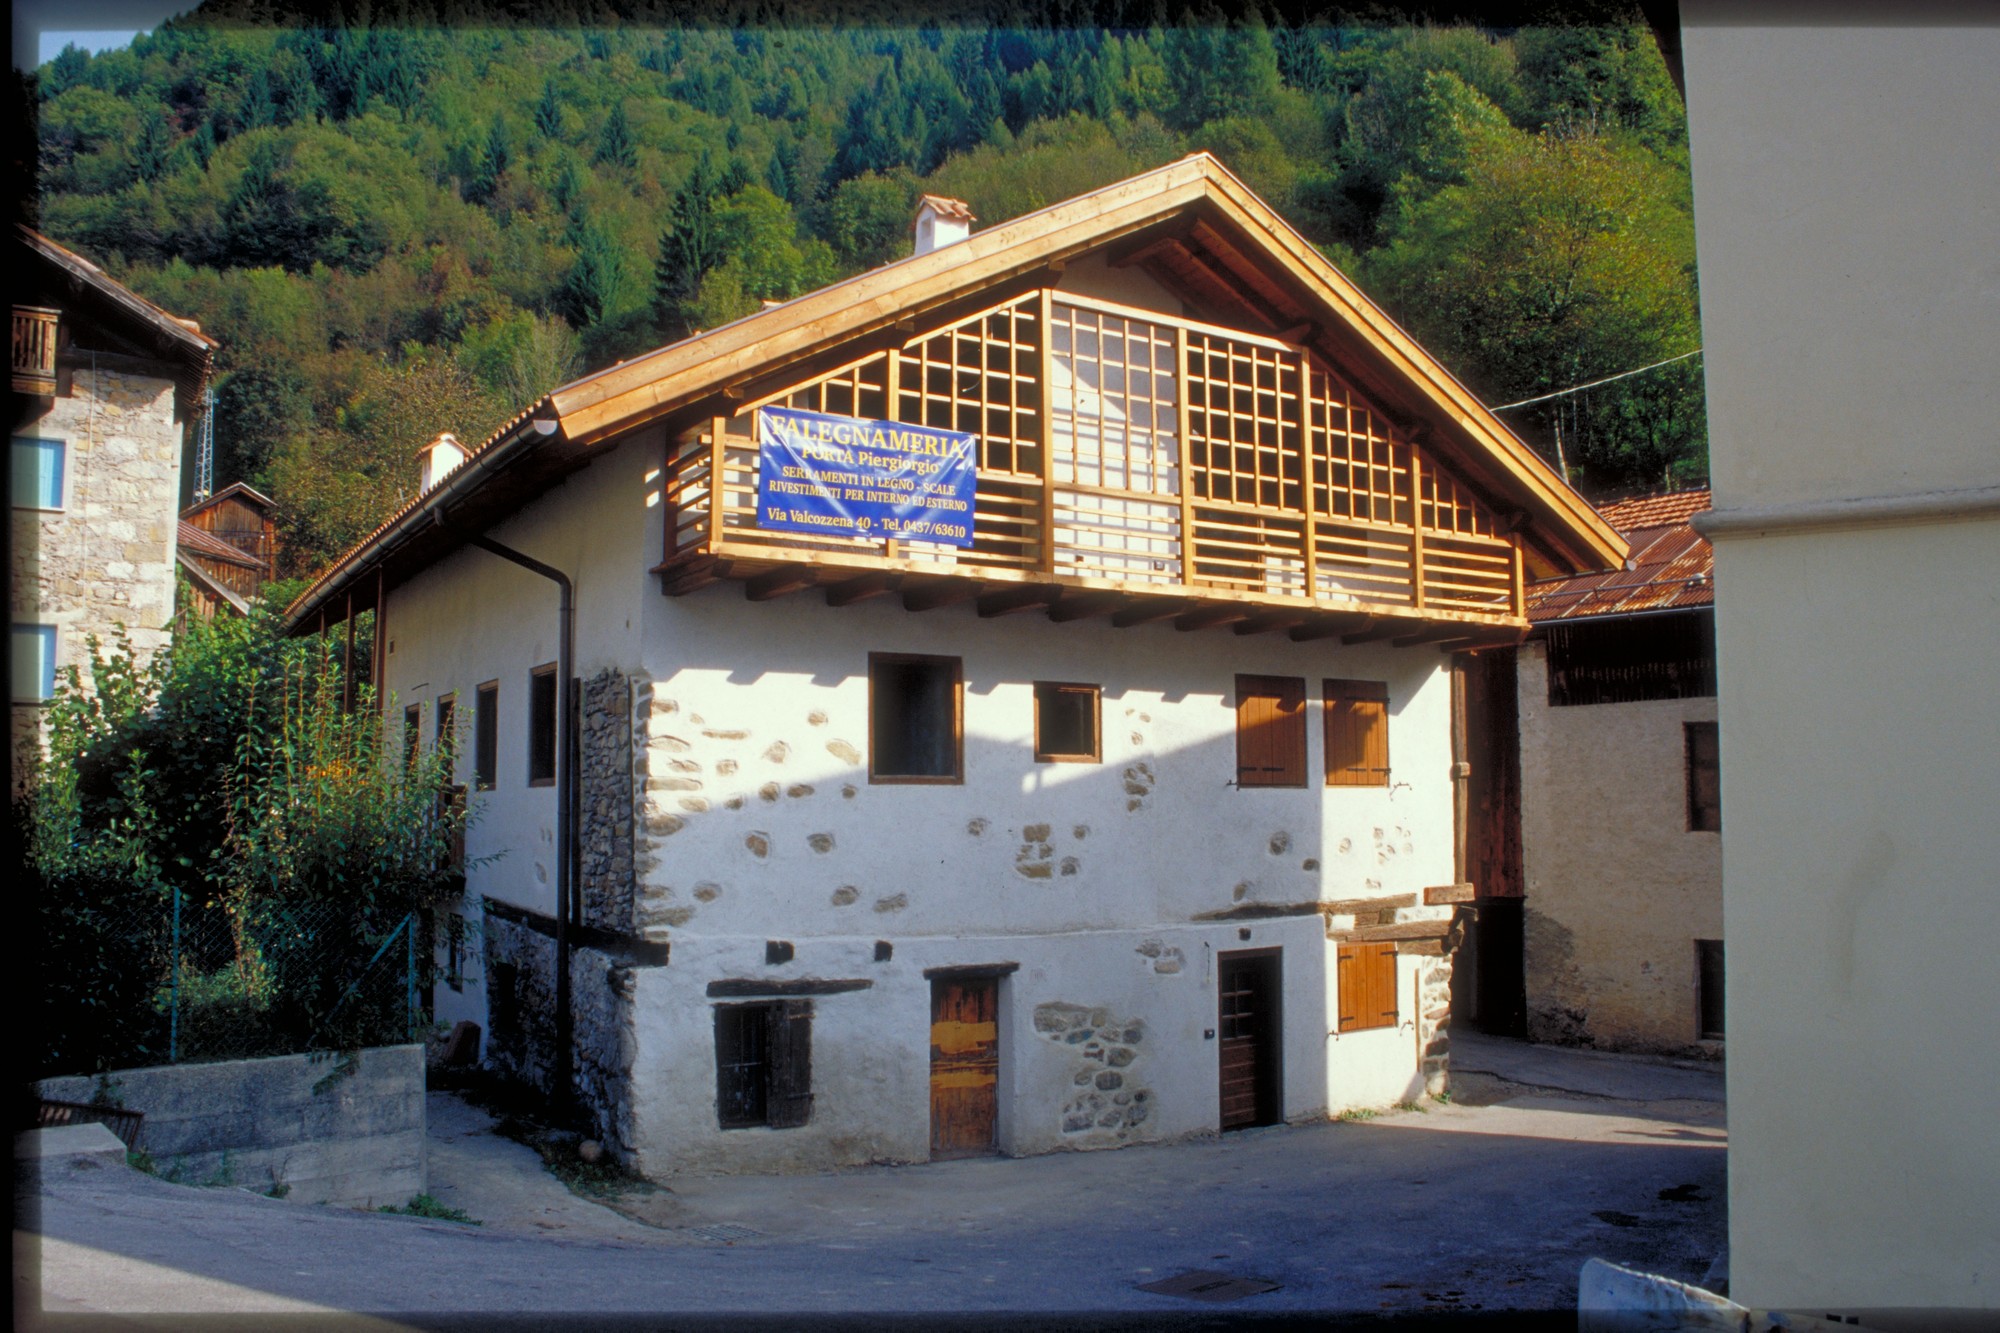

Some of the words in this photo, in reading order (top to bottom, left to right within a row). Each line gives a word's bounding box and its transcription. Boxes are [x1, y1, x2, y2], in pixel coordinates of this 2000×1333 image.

[771, 416, 964, 459] FALEGNAMERIA
[802, 446, 854, 464] PORTA
[859, 451, 939, 475] Piergiorgio
[769, 480, 840, 499] RIVESTIMENTI
[845, 489, 864, 500] PER
[867, 491, 908, 505] INTERNO
[913, 496, 925, 507] ED
[927, 497, 967, 512] ESTERNO
[783, 466, 858, 485] SERRAMENTI
[861, 476, 874, 486] IN
[878, 477, 914, 491] LEGNO
[923, 483, 955, 496] SCALE
[768, 508, 786, 521] Via
[790, 510, 853, 528] Valcozzena
[856, 516, 870, 529] 40
[882, 518, 901, 531] Tel.
[904, 520, 966, 538] 0437/63610
